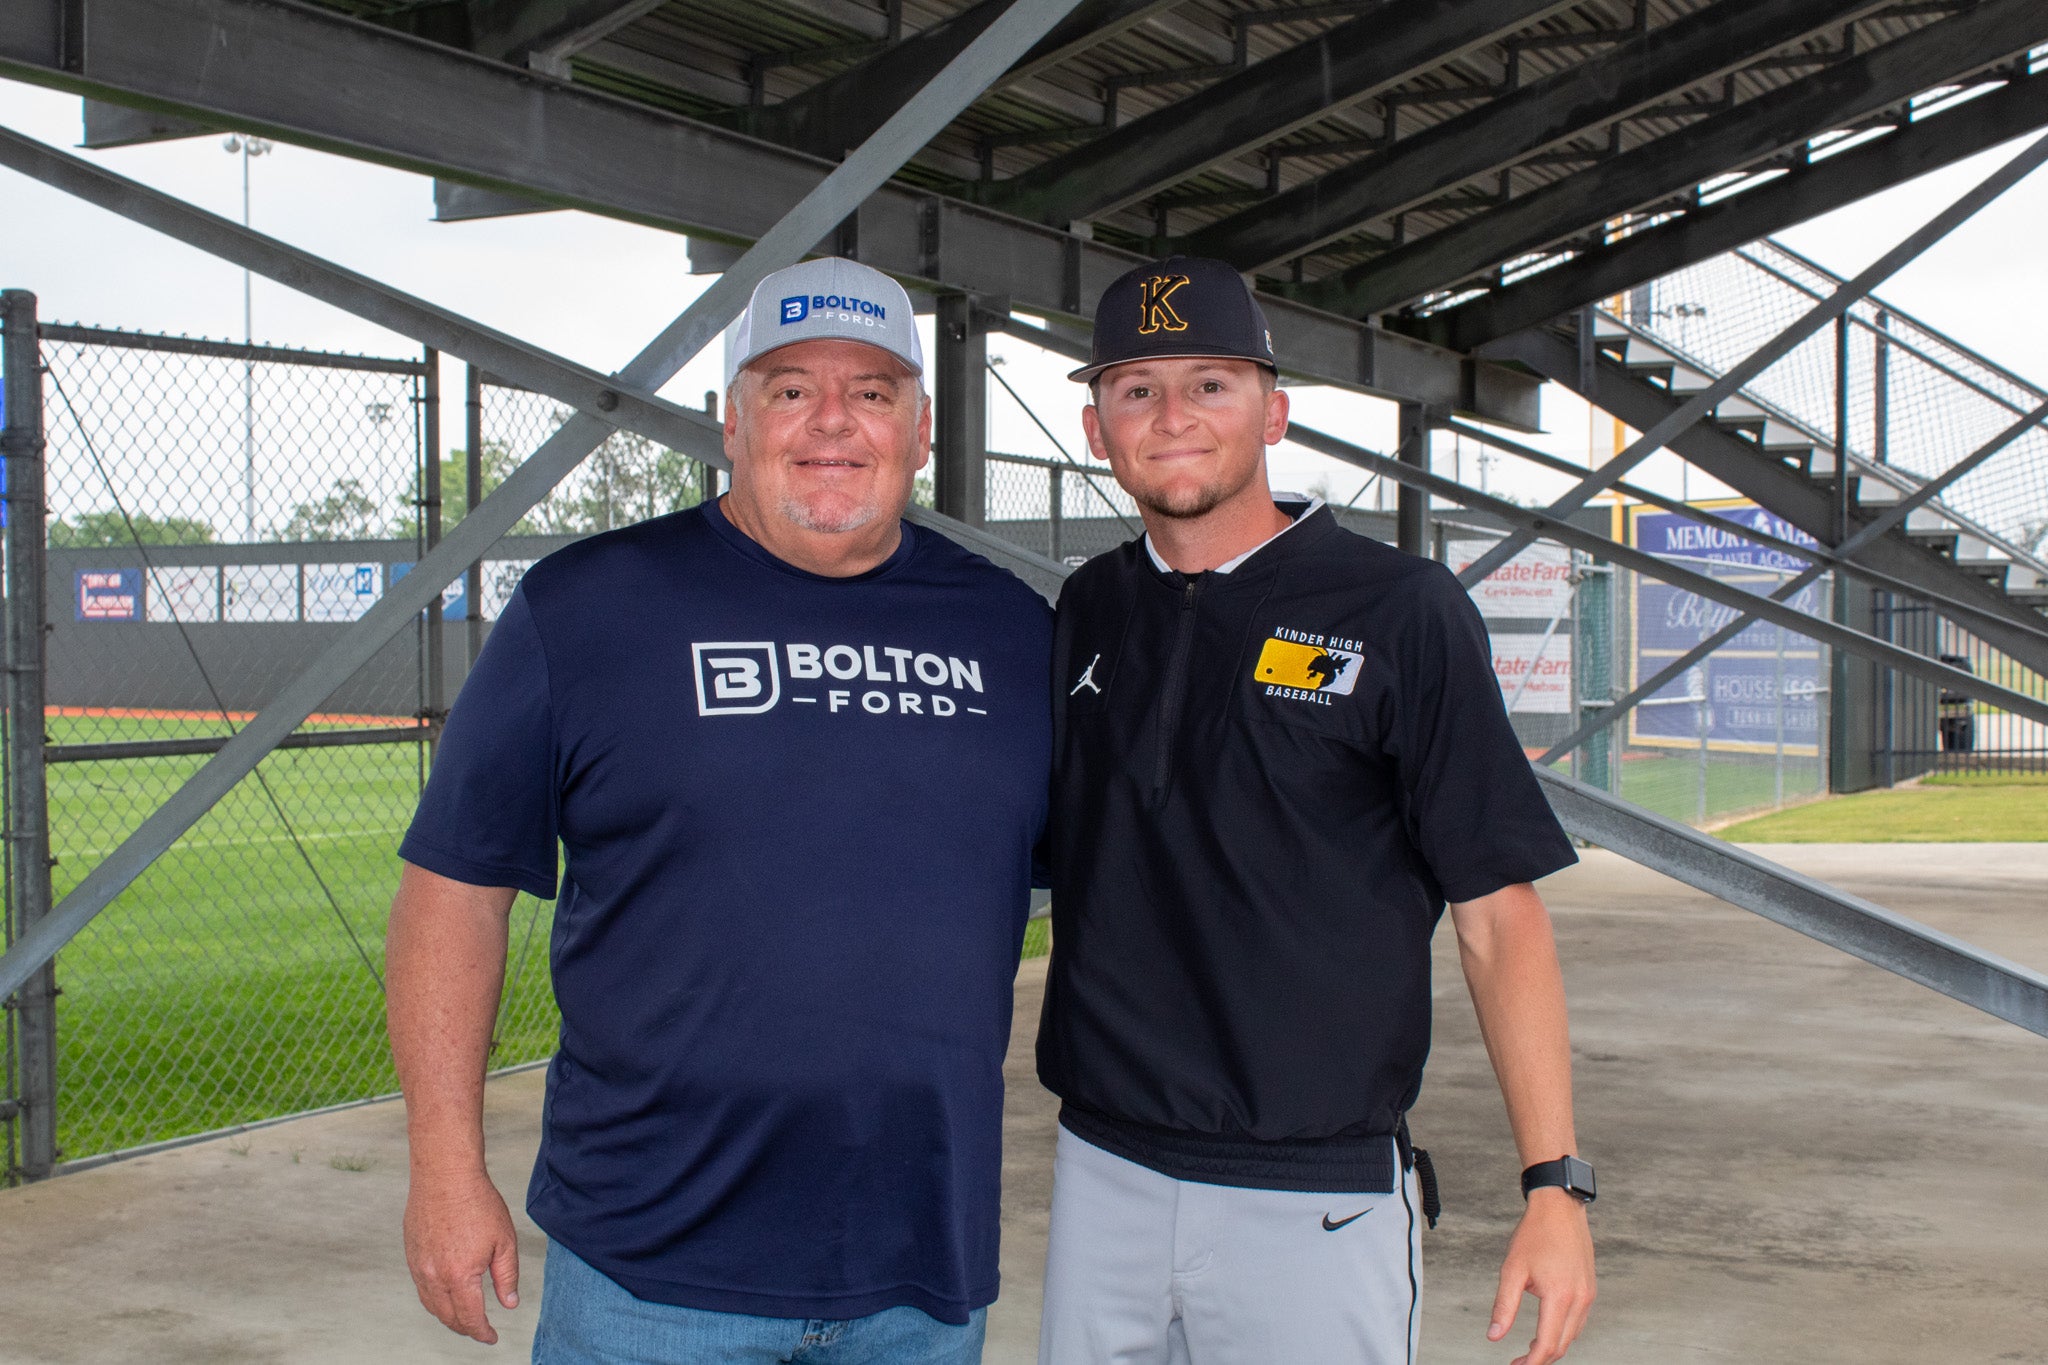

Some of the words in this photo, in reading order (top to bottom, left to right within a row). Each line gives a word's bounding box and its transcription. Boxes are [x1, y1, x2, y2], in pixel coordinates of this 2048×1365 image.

[812, 295, 886, 320] BOLTON
[1138, 275, 1190, 334] K
[826, 311, 874, 327] FORD
[1484, 563, 1531, 582] tate
[1275, 626, 1325, 646] KINDER
[1328, 636, 1364, 652] HIGH
[786, 643, 984, 693] BOLTON
[1493, 656, 1530, 675] tate
[1265, 685, 1332, 706] BASEBALL
[1715, 679, 1773, 699] HOUSE
[828, 690, 957, 717] FORD
